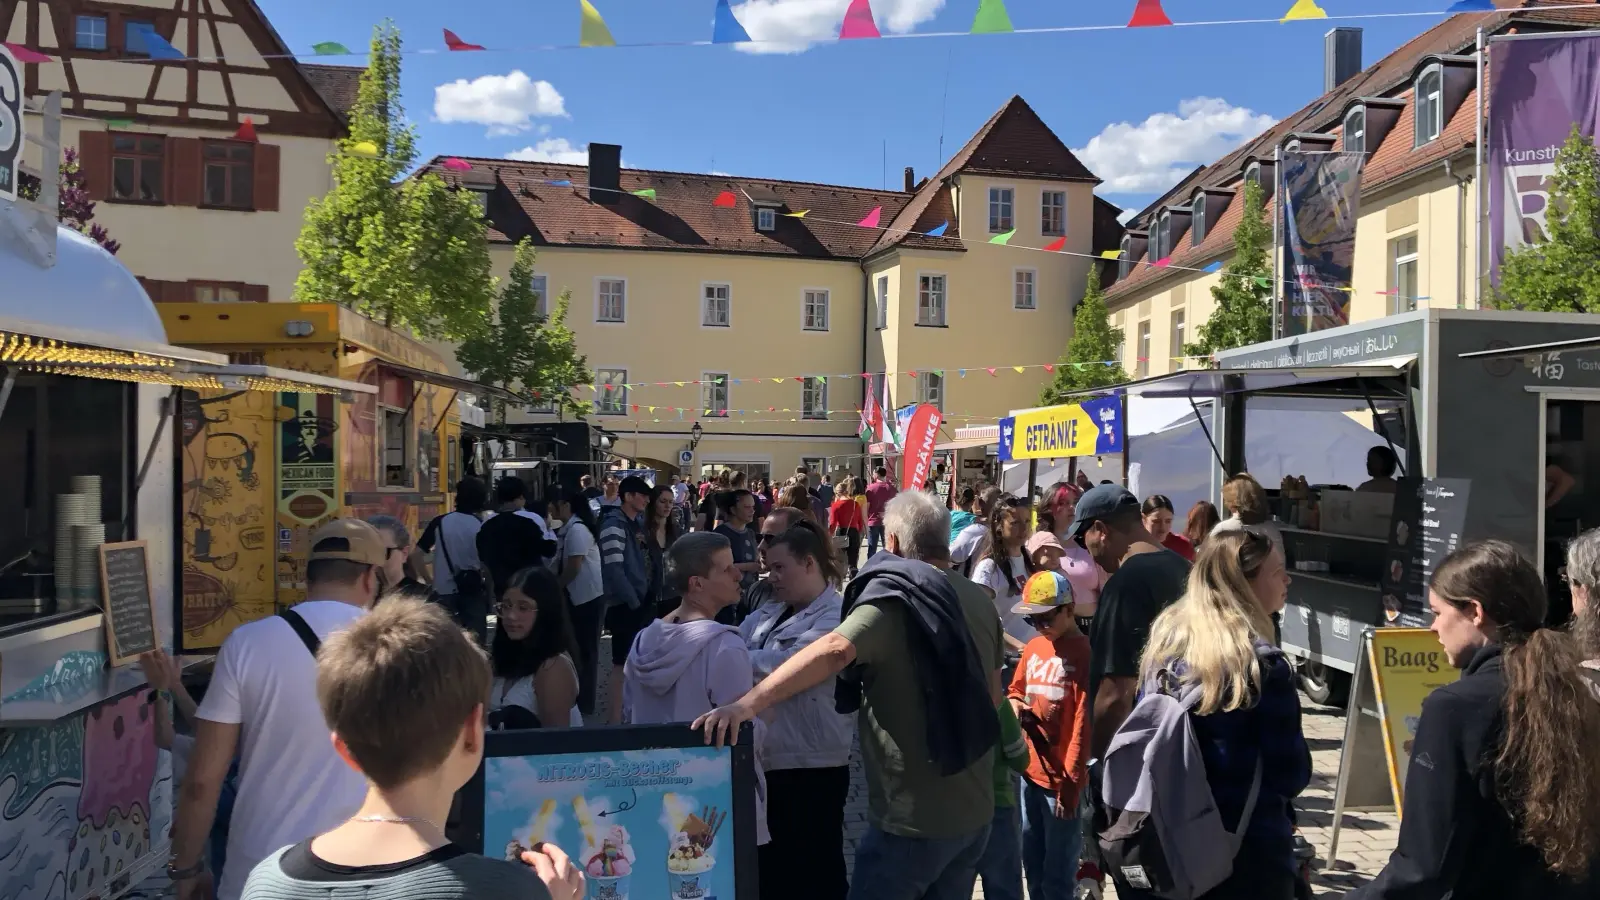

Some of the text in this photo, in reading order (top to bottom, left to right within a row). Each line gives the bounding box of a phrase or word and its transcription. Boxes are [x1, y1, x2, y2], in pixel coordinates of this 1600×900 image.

[1026, 416, 1078, 452] GETRÄNKE
[282, 466, 335, 479] MEXICAN FOOD
